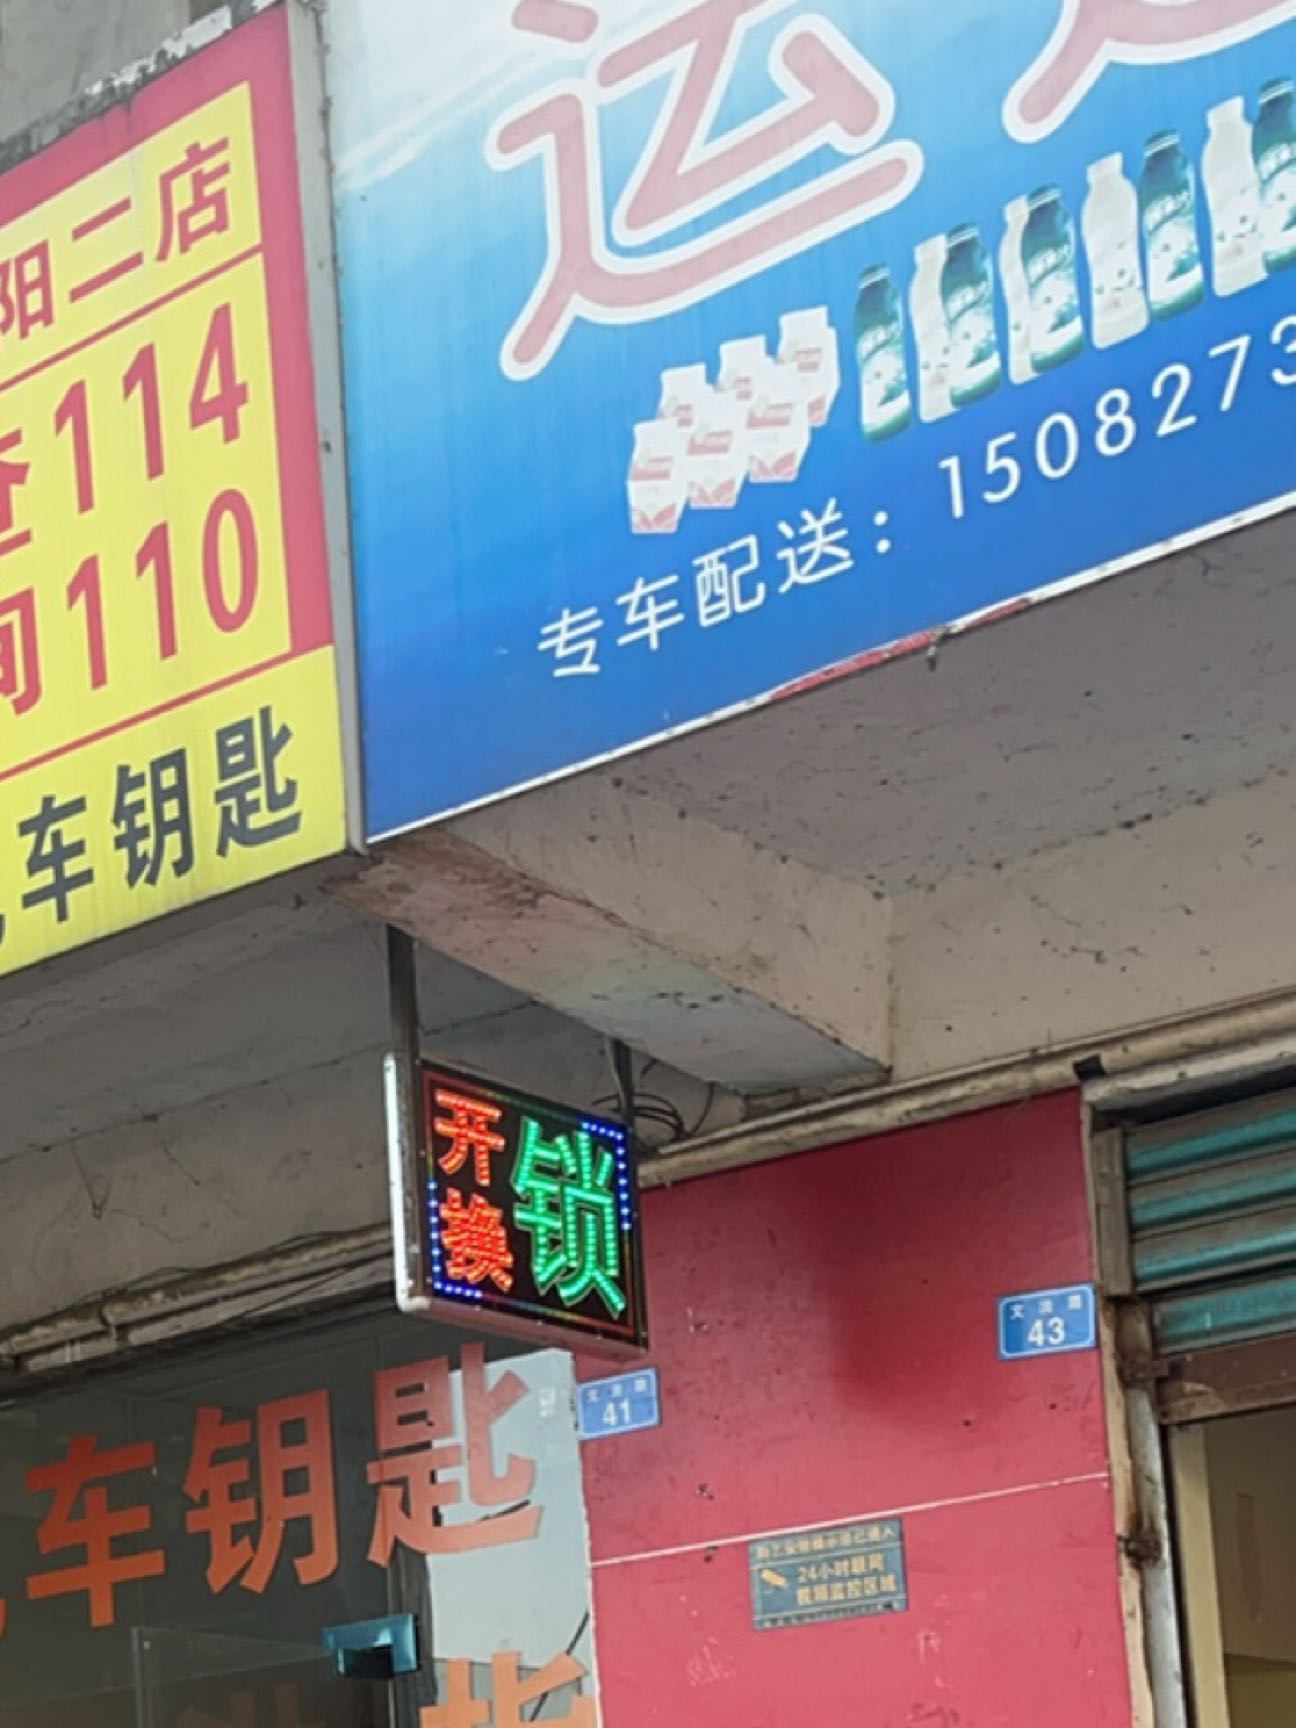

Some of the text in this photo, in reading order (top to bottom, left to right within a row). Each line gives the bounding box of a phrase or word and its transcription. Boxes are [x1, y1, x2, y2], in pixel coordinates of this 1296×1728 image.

[54, 302, 250, 517] 114
[939, 314, 1296, 520] 1508273
[65, 488, 261, 691] 110
[509, 1116, 626, 1320] 锁
[602, 1396, 630, 1427] 41
[1028, 1316, 1066, 1347] 43
